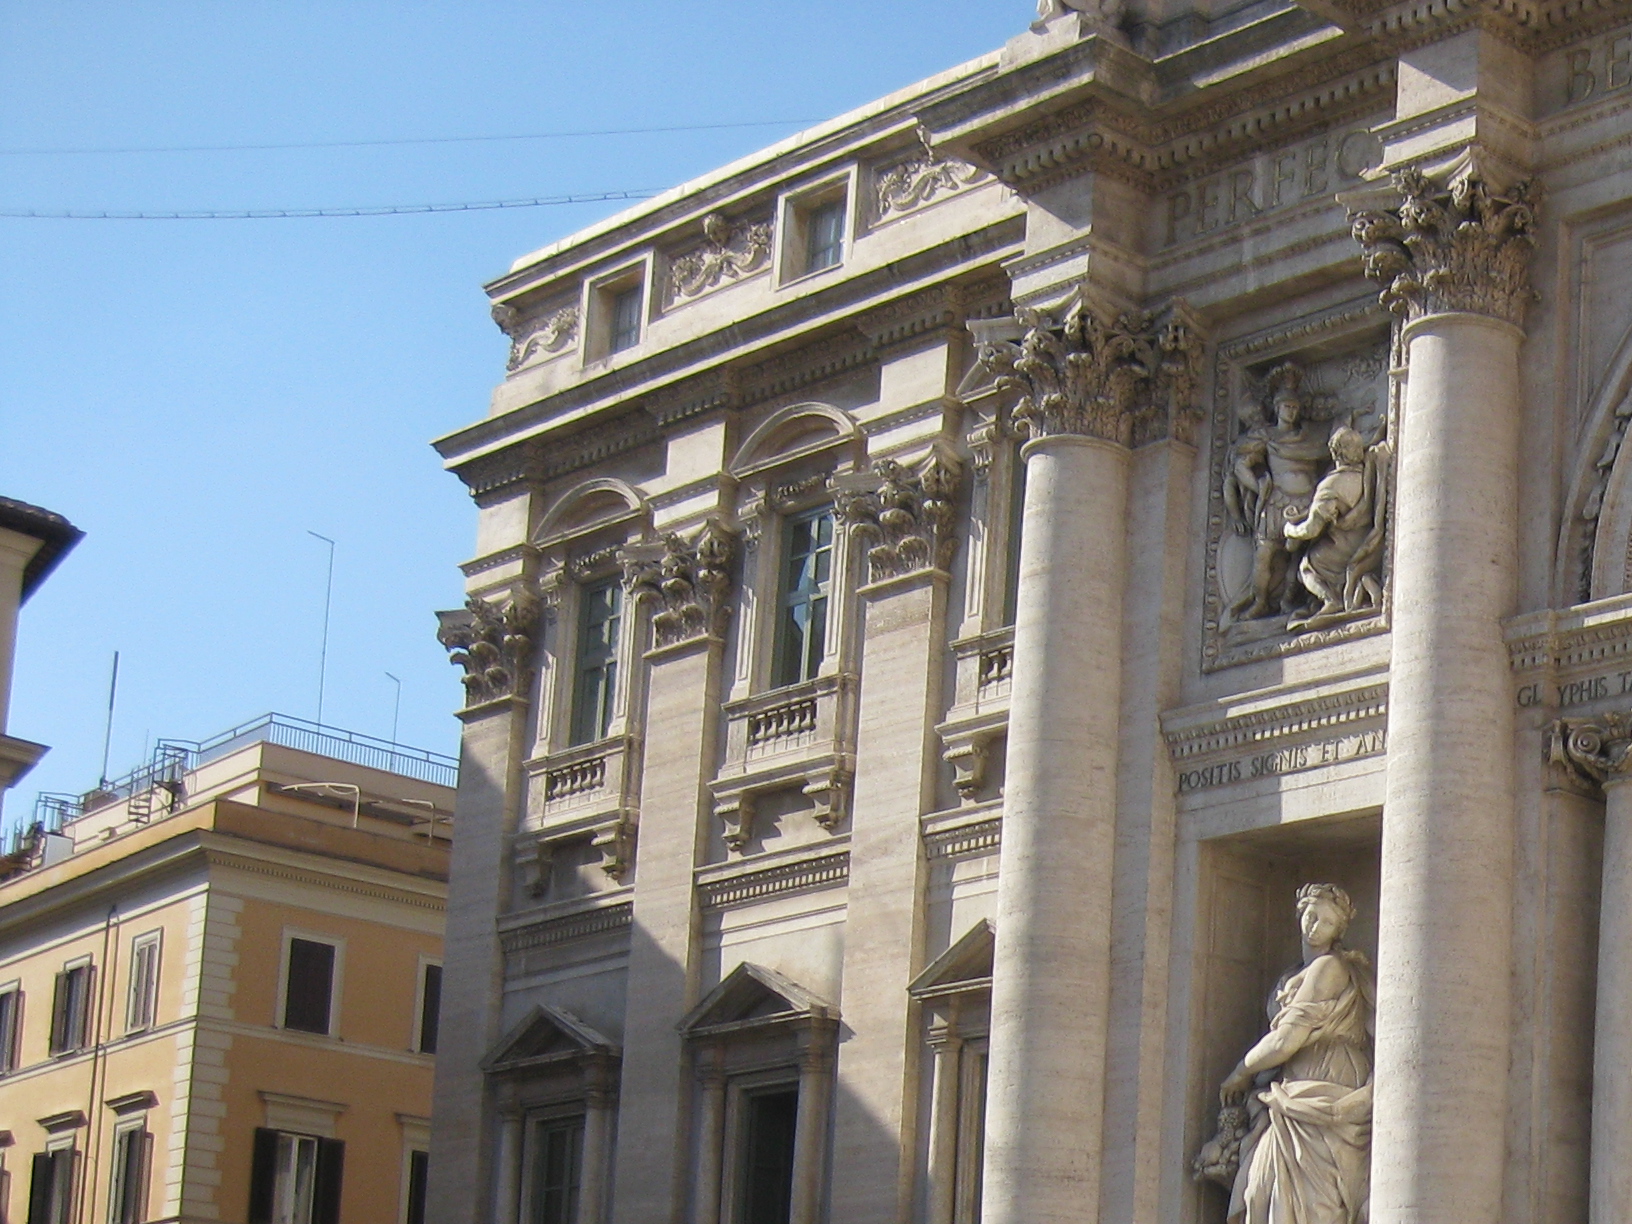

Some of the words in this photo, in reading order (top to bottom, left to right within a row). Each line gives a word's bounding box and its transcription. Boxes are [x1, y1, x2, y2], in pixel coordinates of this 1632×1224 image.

[1178, 760, 1242, 793] POSITIS
[1250, 747, 1309, 778] SIGNIS
[1321, 739, 1345, 763] ET
